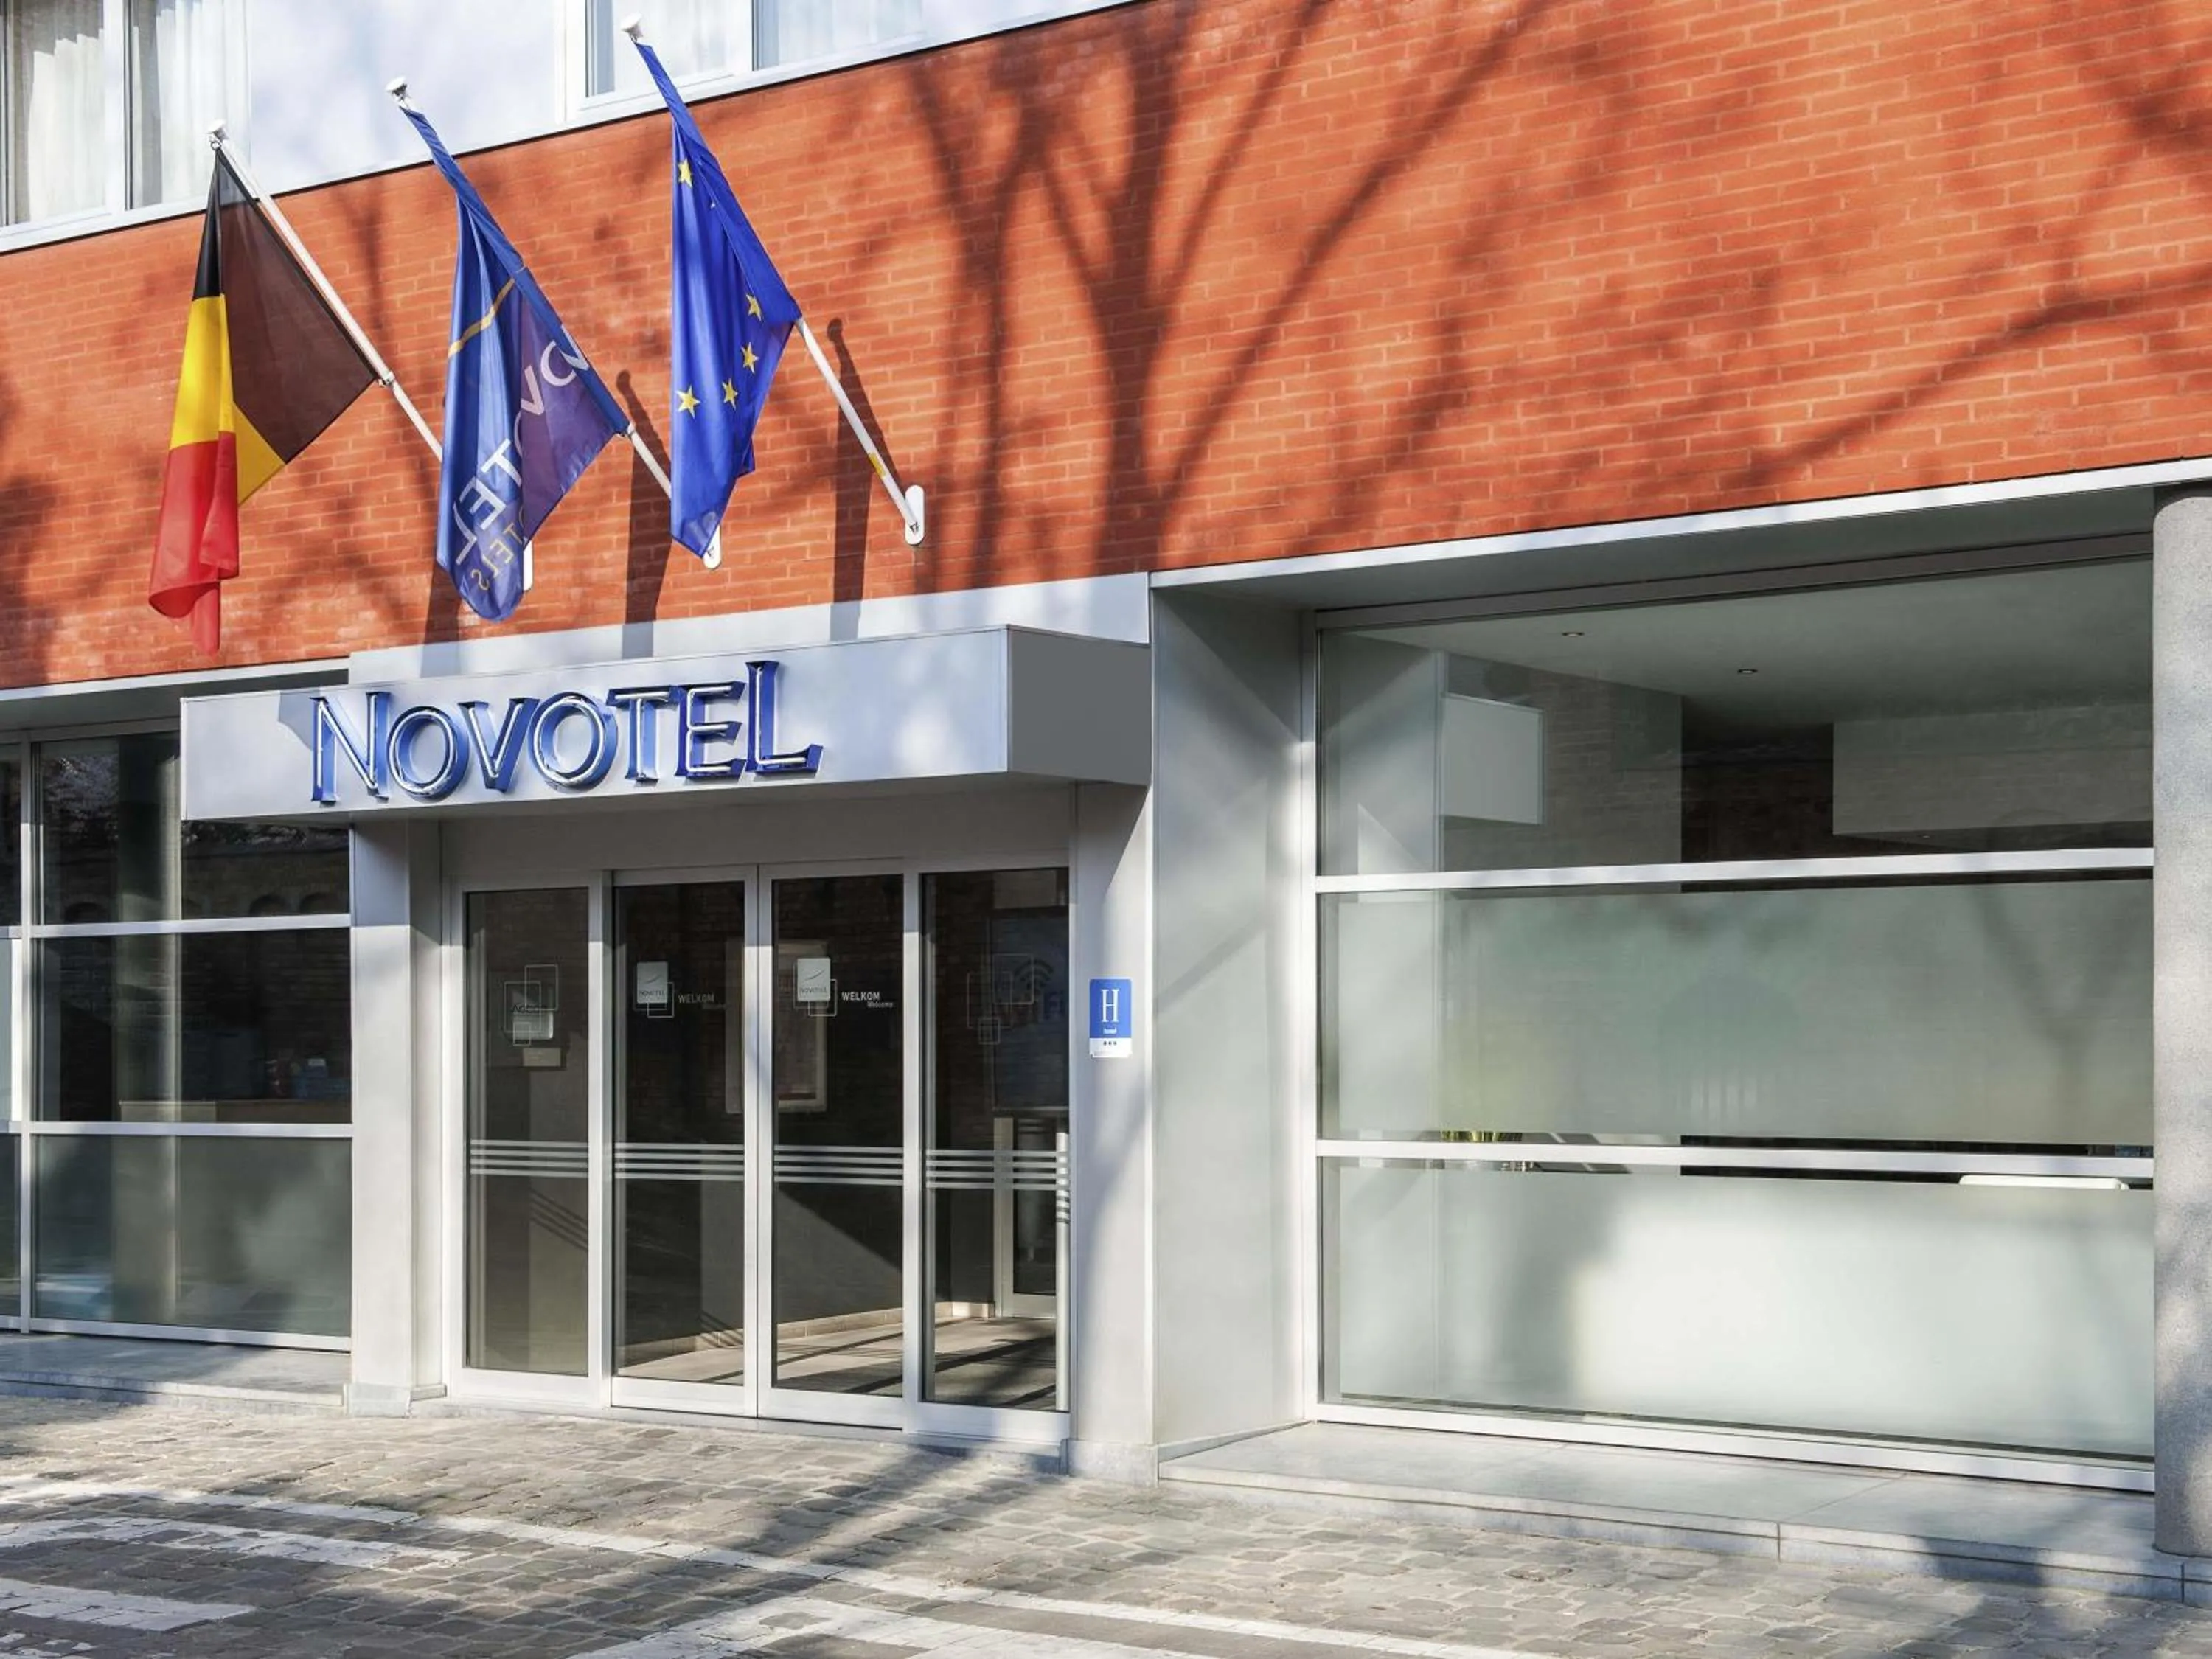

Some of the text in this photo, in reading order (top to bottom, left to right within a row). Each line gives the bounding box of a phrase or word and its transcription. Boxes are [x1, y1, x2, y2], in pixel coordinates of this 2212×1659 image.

[310, 660, 824, 805] NOVOTEL
[678, 992, 714, 1004] WELKOM
[841, 991, 880, 1001] WELKOM
[1101, 989, 1120, 1023] H
